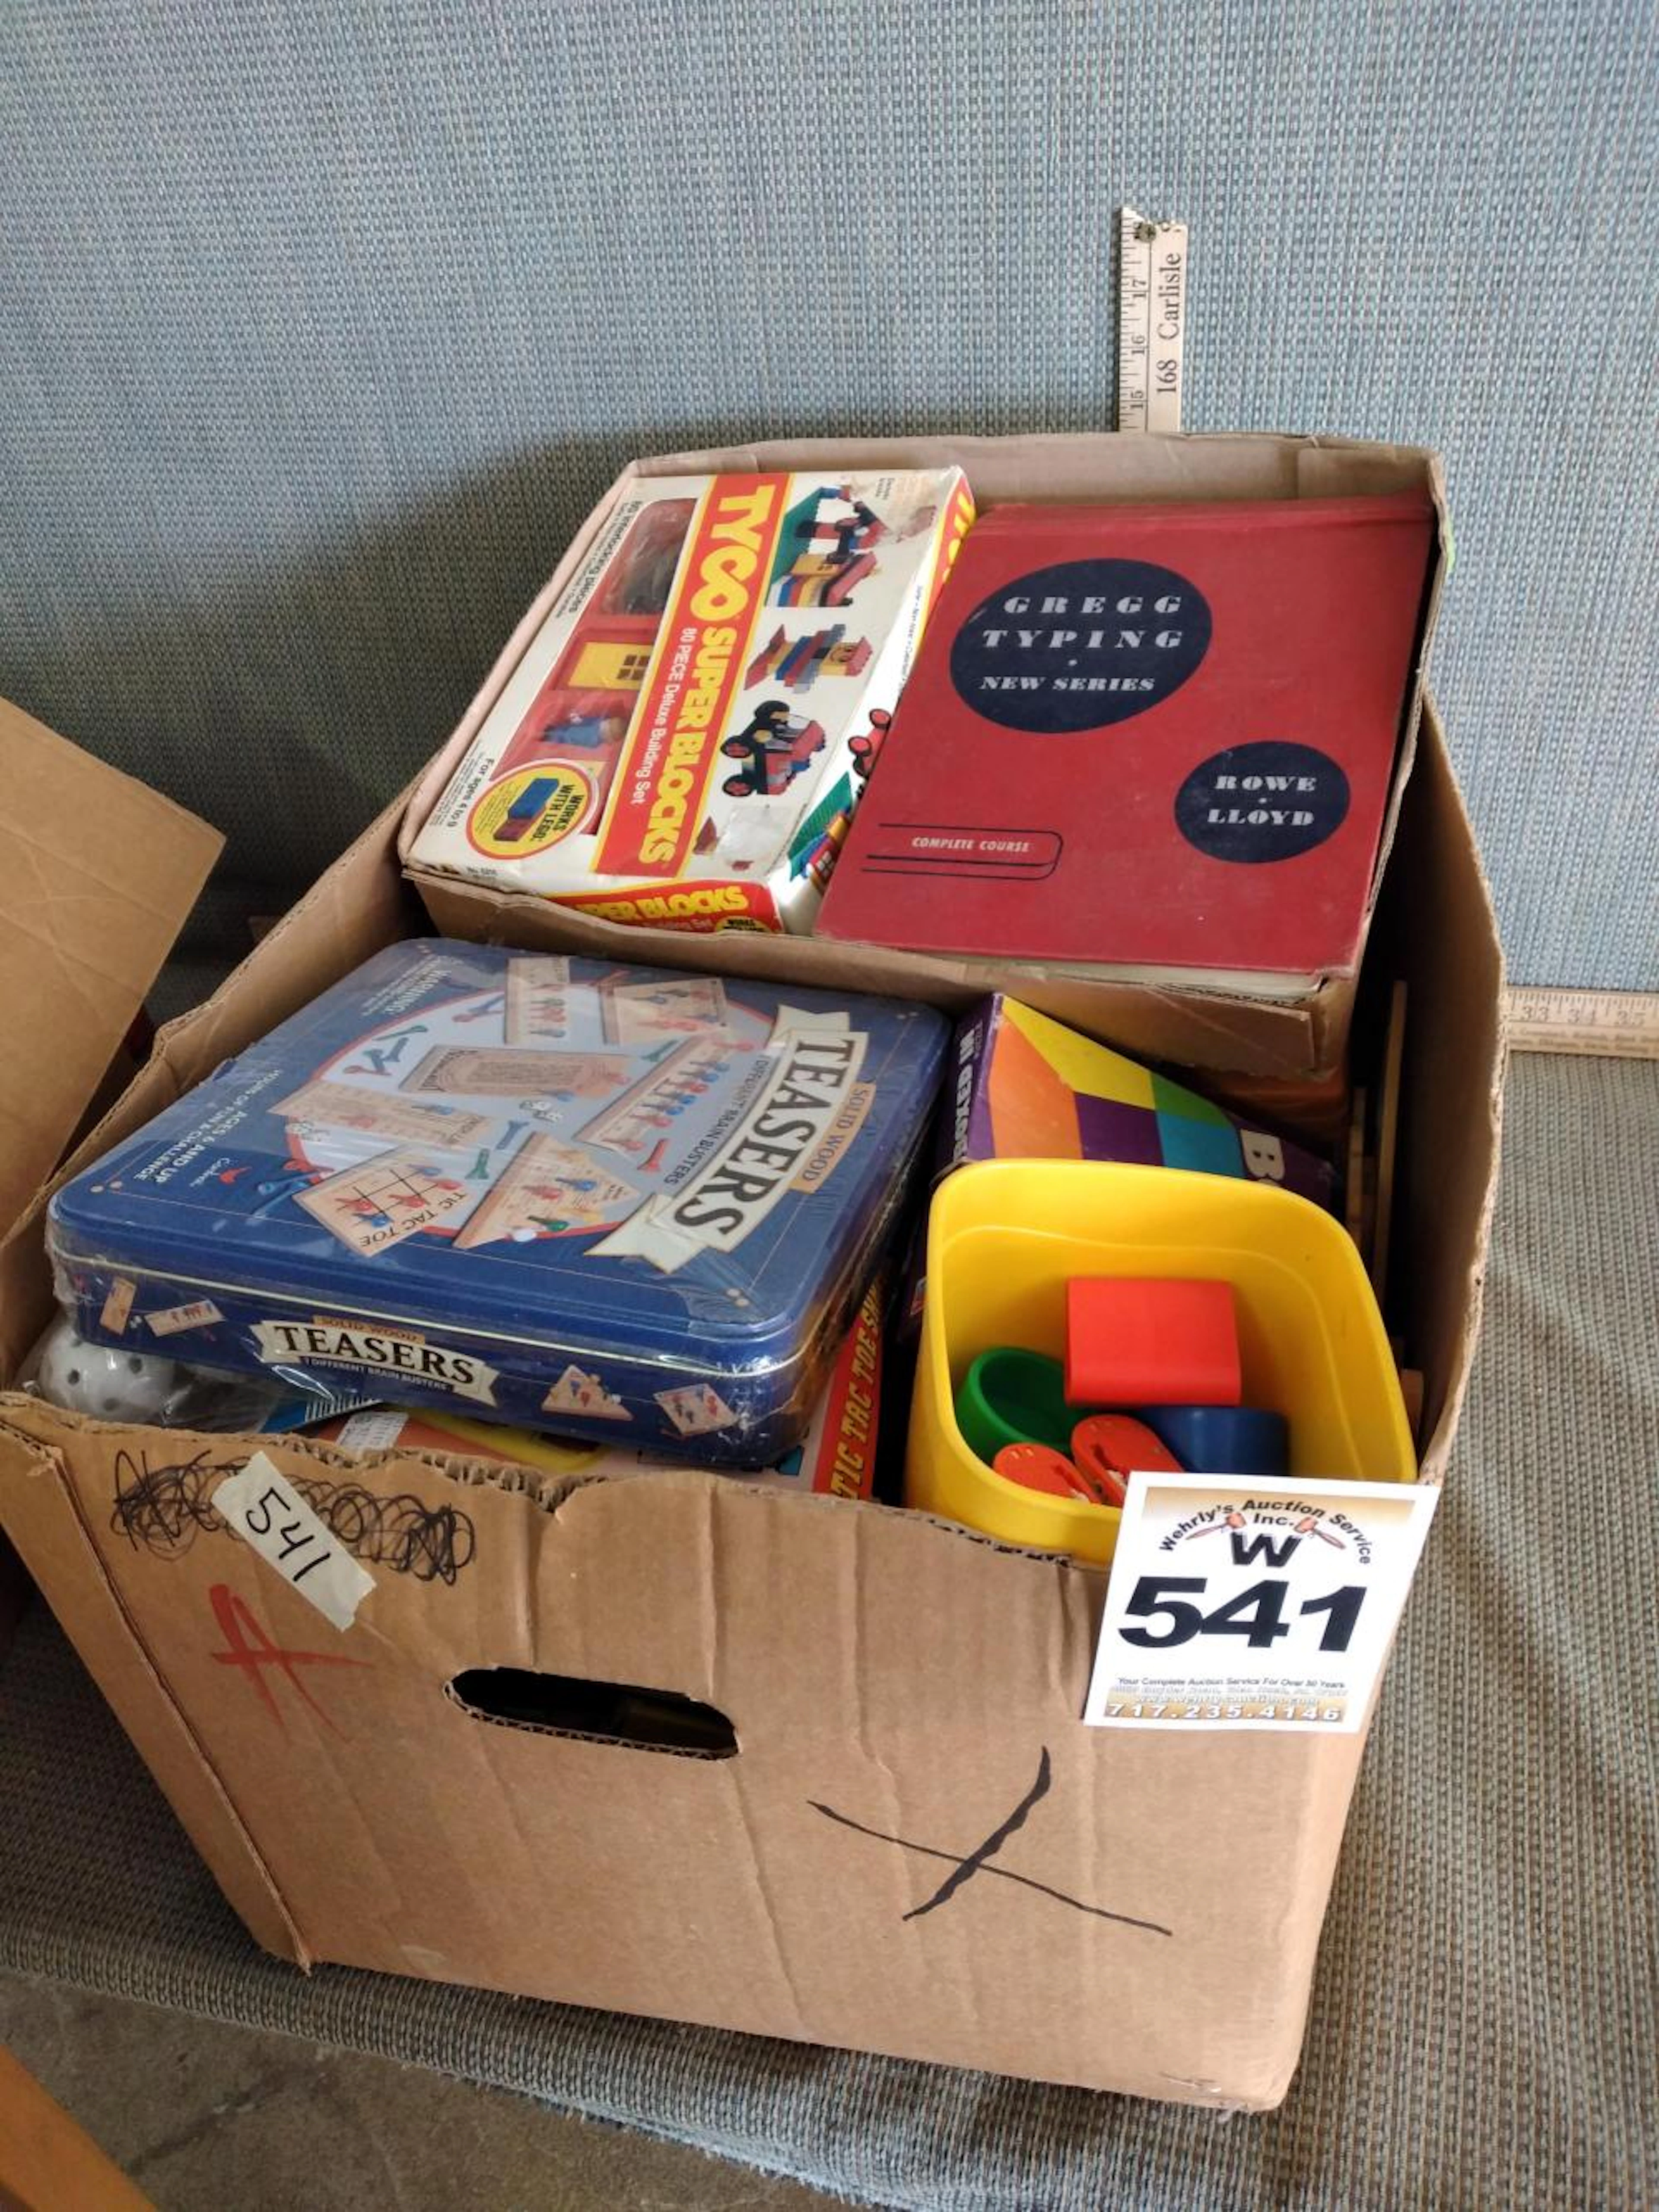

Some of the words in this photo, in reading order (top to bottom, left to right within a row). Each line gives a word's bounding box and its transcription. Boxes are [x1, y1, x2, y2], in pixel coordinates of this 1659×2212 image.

[1132, 279, 1147, 299] 17
[1157, 253, 1181, 340] Carlisle
[1131, 335, 1145, 355] 16
[1157, 360, 1177, 394] 168
[1131, 390, 1144, 410] 15
[690, 484, 776, 621] TYCO
[1004, 596, 1182, 614] GREGG
[680, 627, 697, 643] 80
[982, 630, 1182, 649] TYPING
[671, 644, 691, 683] PIECE
[676, 627, 737, 730] SUPER
[979, 676, 1046, 690] NEW
[1052, 677, 1156, 691] SERIES
[655, 684, 680, 725] Deluxe
[637, 727, 667, 778] Building
[549, 784, 575, 811] WITH
[631, 780, 651, 805] Set
[639, 731, 707, 864] BLOCKS
[1214, 776, 1317, 792] ROWE
[553, 794, 585, 831] WORKS
[1207, 808, 1315, 826] LLOYD
[912, 837, 974, 850] COMPLETE
[979, 840, 1030, 853] COURSE
[637, 886, 749, 919] BLOCKS
[212, 1111, 248, 1136] AGES
[837, 1086, 868, 1129] SOLID
[674, 1039, 855, 1235] TEASERS
[173, 1144, 205, 1167] AND
[664, 1139, 714, 1184] BUSTERS
[803, 1135, 844, 1181] WOOD
[155, 1168, 178, 1183] UP
[438, 1192, 467, 1209] TIC
[401, 1209, 438, 1230] TAC
[359, 1226, 400, 1247] TOE
[274, 1326, 475, 1384] TEASERS
[852, 1326, 877, 1384] TOE
[841, 1381, 874, 1444] TAC
[830, 1441, 864, 1499] TIC
[245, 1487, 331, 1582] 541
[1159, 1504, 1234, 1552] Wehrly's
[1242, 1499, 1326, 1518] Auction
[1329, 1514, 1373, 1564] Service
[1253, 1514, 1294, 1526] Inc.
[1230, 1531, 1303, 1568] W
[1118, 1575, 1367, 1652] 541
[1141, 1677, 1185, 1687] Complete
[1280, 1678, 1304, 1687] Over
[1320, 1680, 1346, 1688] Years
[1107, 1703, 1341, 1721] 717.235.4146
